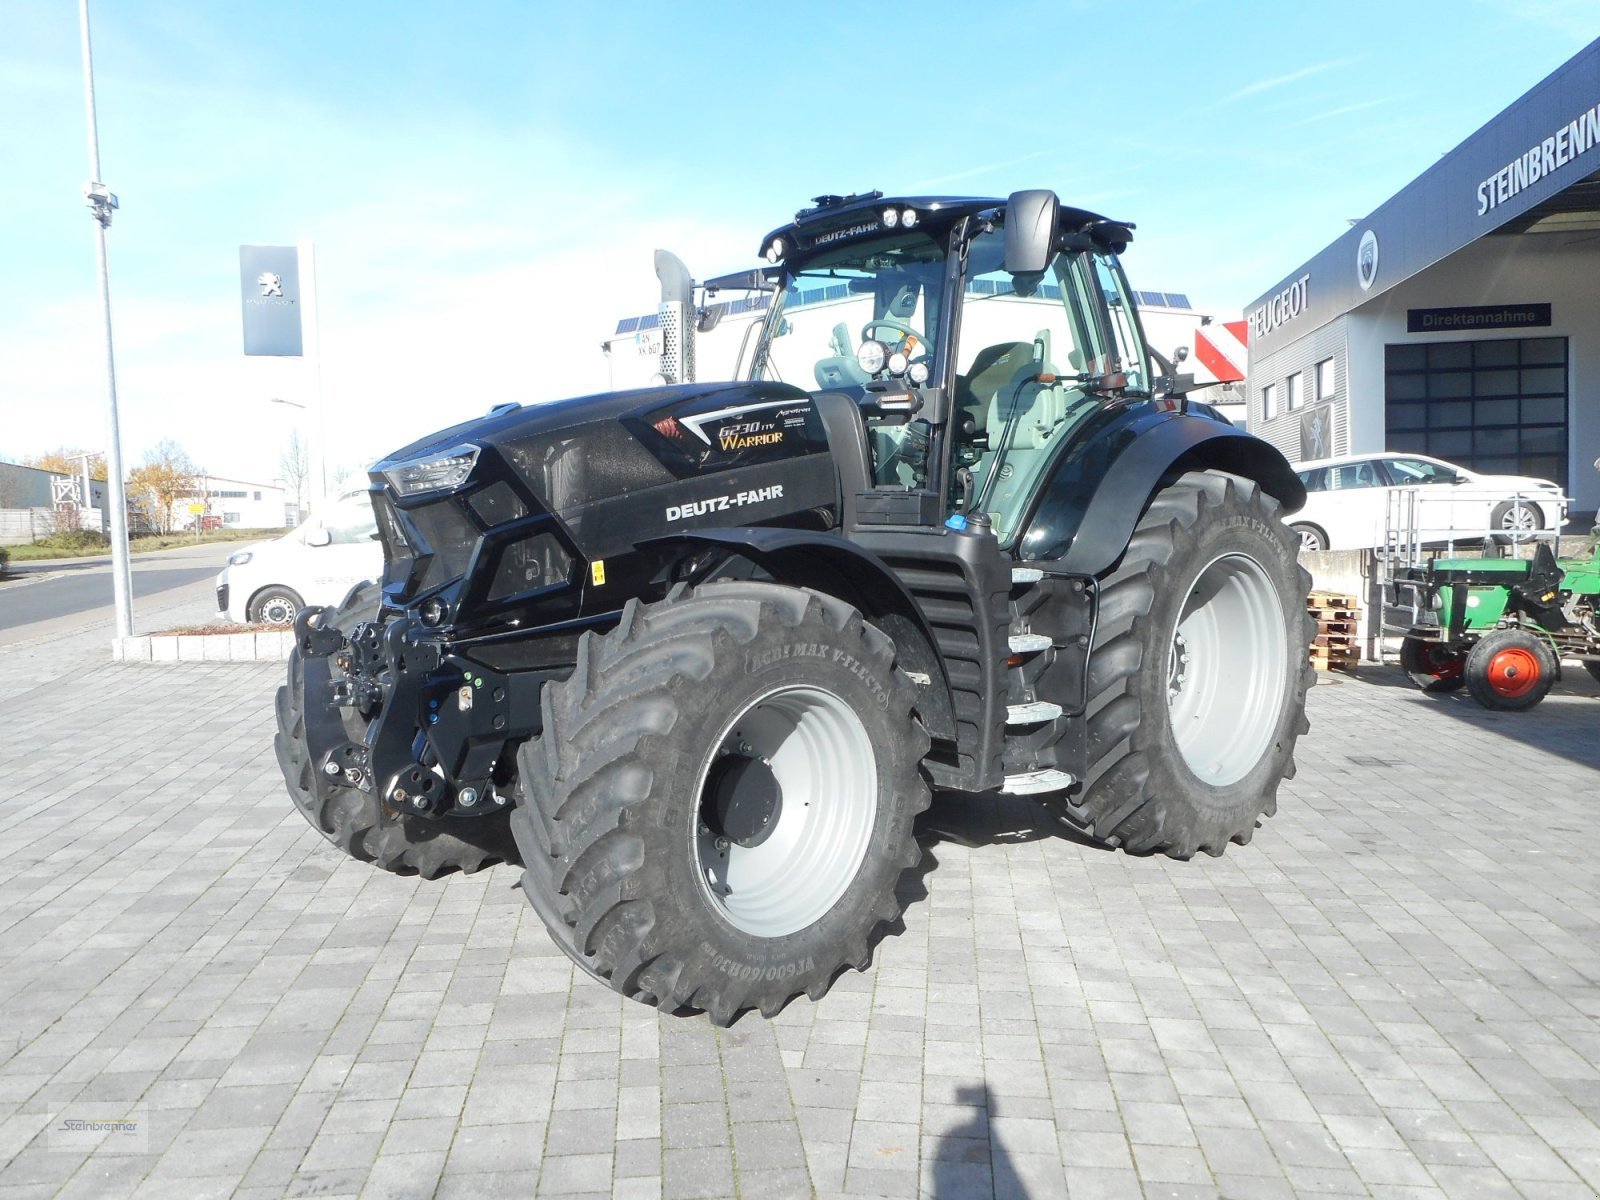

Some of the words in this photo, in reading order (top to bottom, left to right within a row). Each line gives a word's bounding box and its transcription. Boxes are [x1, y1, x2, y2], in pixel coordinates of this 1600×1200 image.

[1477, 103, 1600, 217] STEINBRENN
[815, 222, 879, 245] DEUTZ-FAHR
[1422, 309, 1536, 328] Direktannahme
[719, 421, 760, 438] 6230
[666, 484, 784, 522] DEUTZ-FAHR
[832, 649, 887, 702] V-FLECTO
